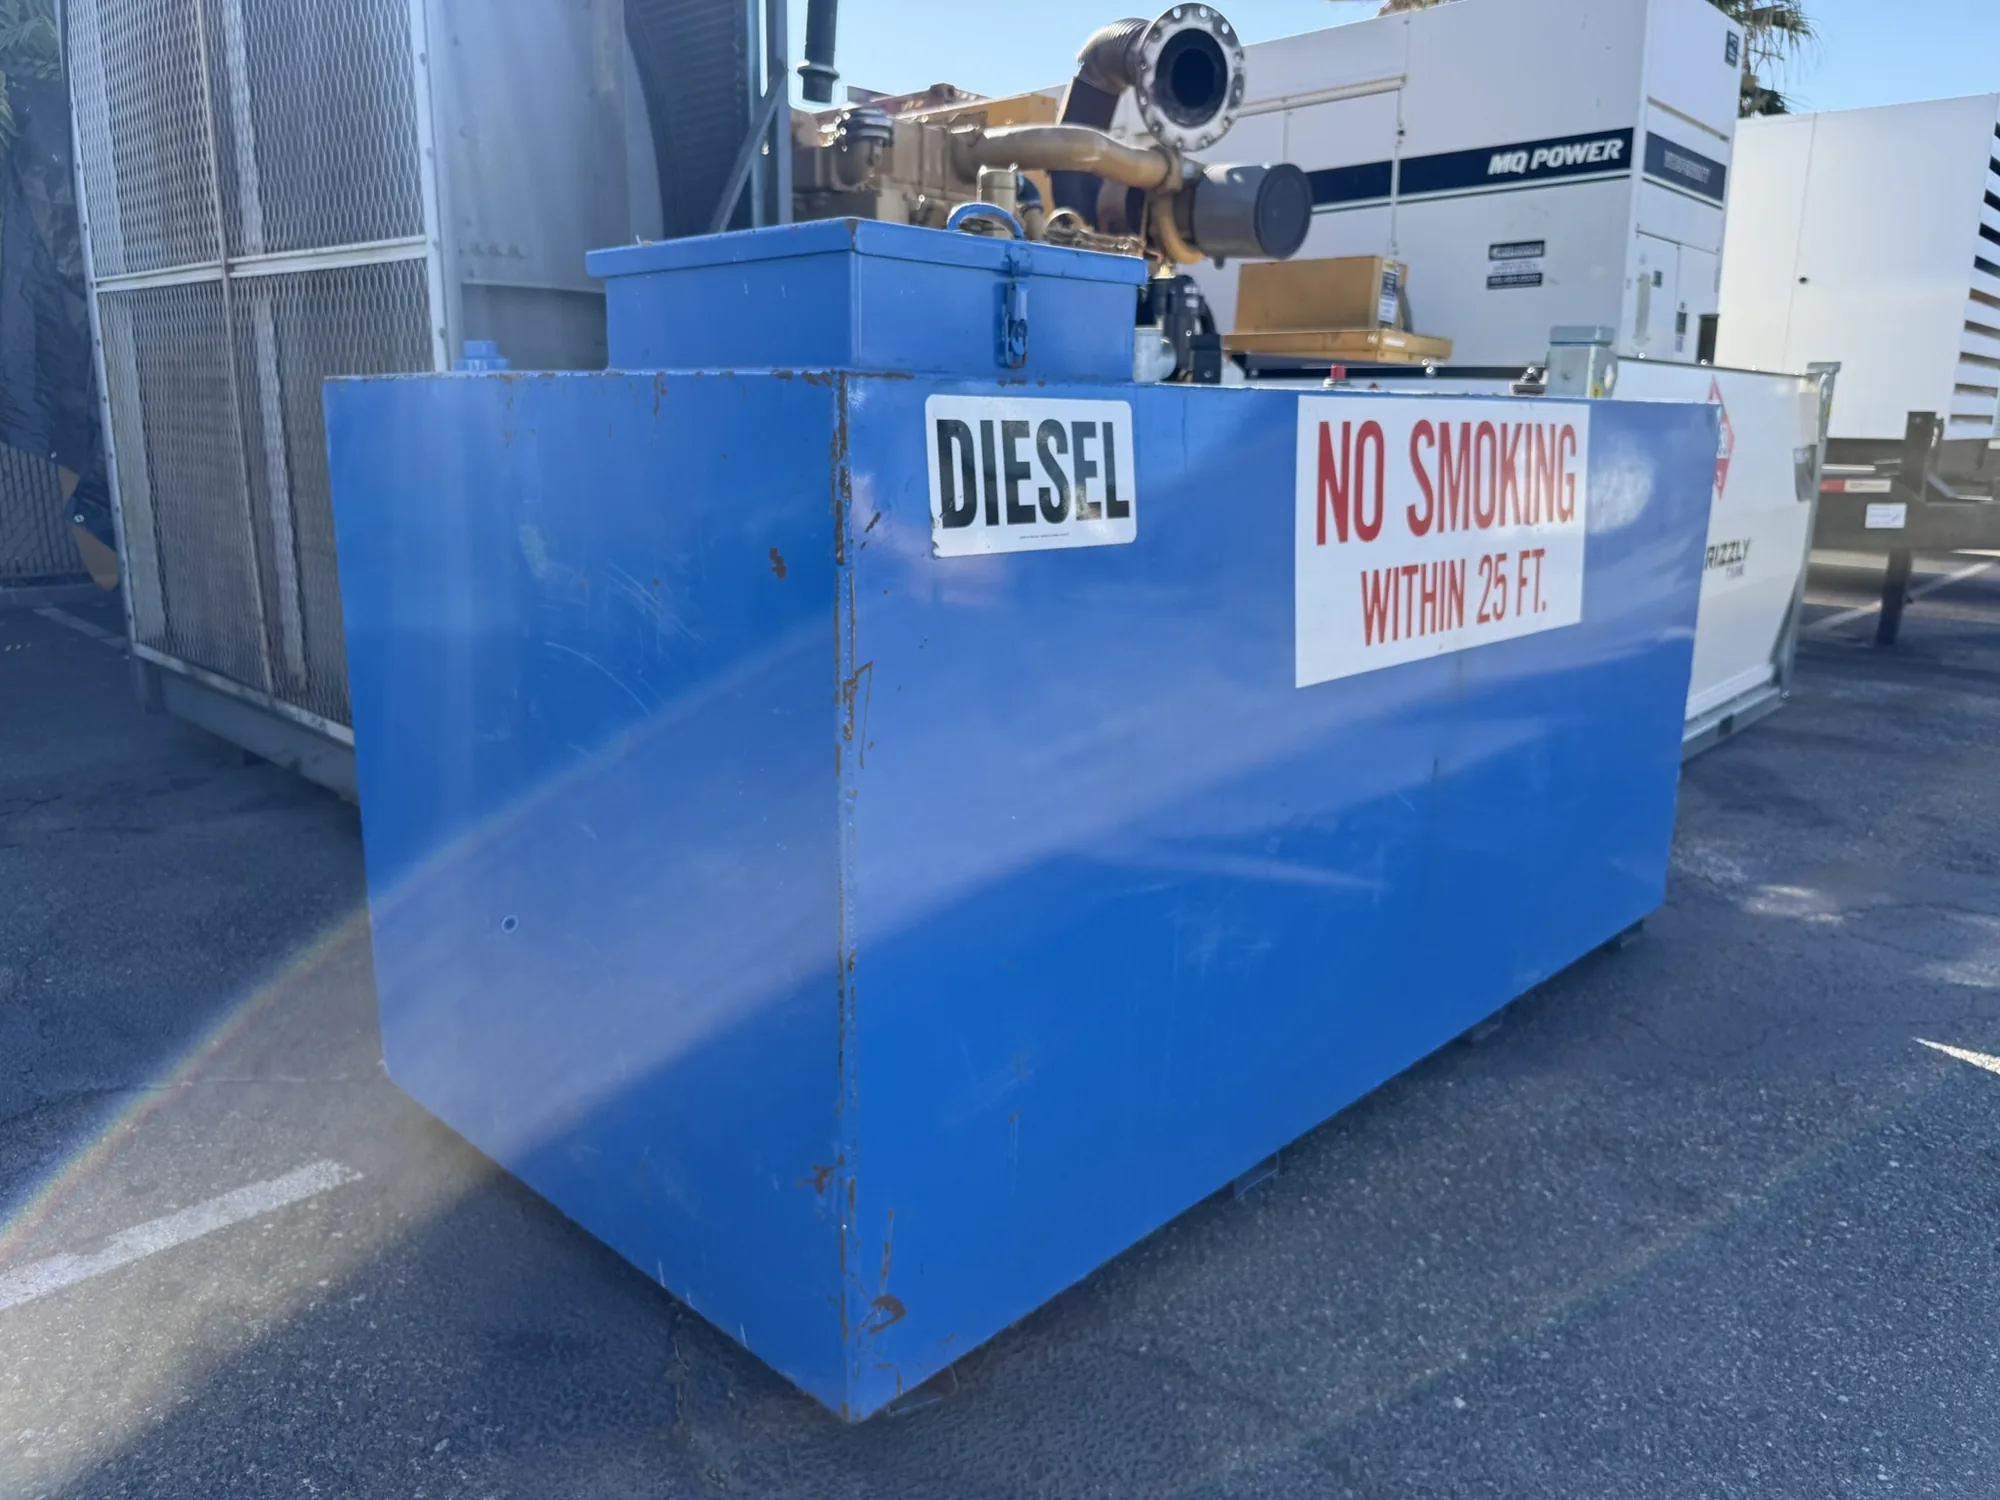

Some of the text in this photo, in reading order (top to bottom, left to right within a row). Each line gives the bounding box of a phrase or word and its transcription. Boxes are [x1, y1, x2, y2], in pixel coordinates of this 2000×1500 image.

[1487, 138, 1624, 175] MQ POWER
[937, 419, 1130, 528] DIESEL
[1316, 419, 1576, 545] NO SMOKING
[1361, 548, 1546, 646] WITHIN 25 FT.
